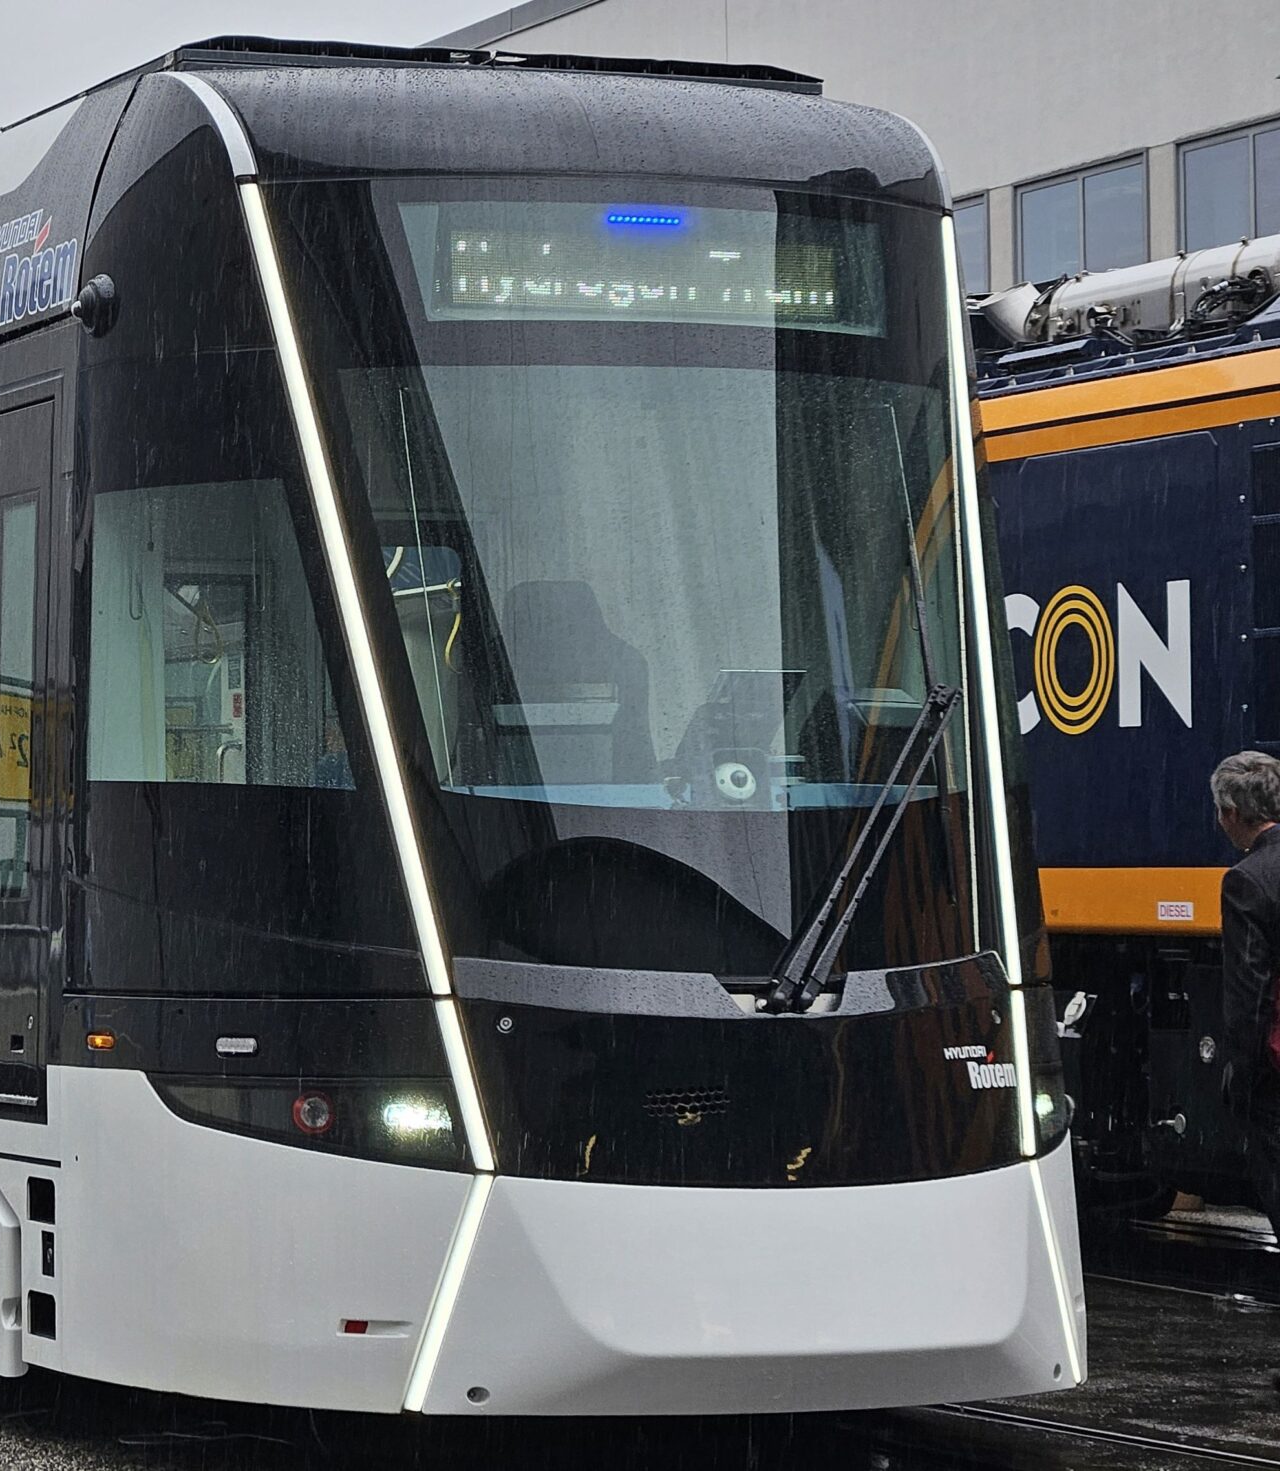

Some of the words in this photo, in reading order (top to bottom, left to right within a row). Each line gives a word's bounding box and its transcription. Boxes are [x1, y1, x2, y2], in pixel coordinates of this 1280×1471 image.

[1160, 904, 1192, 918] DIESEL
[943, 1046, 987, 1060] HYUNDAI
[966, 1061, 1018, 1089] Rotem
